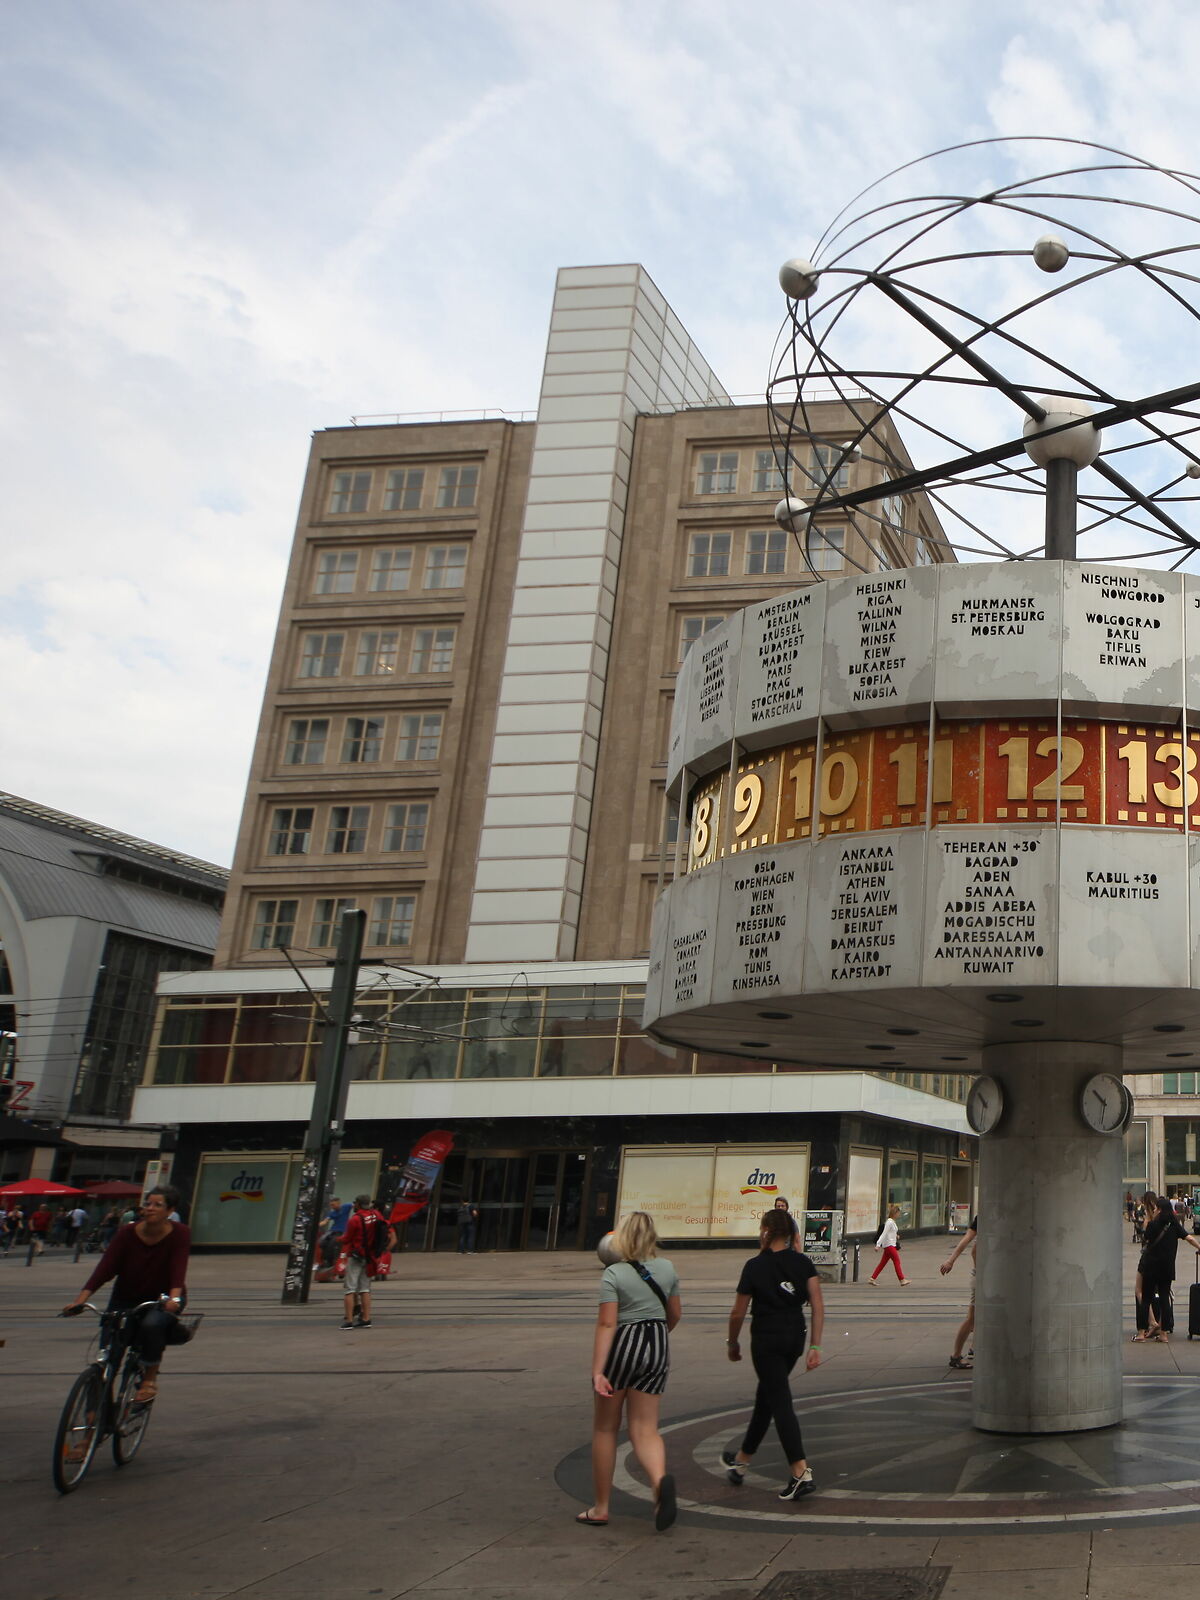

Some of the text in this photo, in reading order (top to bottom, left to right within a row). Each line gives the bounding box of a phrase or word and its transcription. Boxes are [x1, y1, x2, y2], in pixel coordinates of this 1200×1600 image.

[856, 579, 906, 596] HELSINKI
[1082, 574, 1139, 588] NISCHNIJ
[867, 594, 892, 607] RIGA
[1102, 588, 1164, 604] NOWGOROD
[758, 595, 810, 620] AMSTERDAM
[962, 598, 1036, 610] MURMANSK
[767, 611, 799, 629] BERLIN
[858, 606, 902, 621] TALLINN
[951, 611, 1045, 623] ST. PETERSBURG
[1086, 612, 1160, 628] WOLGOGRAD
[862, 620, 896, 634] WILNA
[971, 625, 1024, 636] MOSKAU
[1107, 628, 1139, 640] BAKU
[759, 634, 804, 656] BUDAPEST
[860, 633, 896, 647] MINSK
[864, 647, 890, 660] KIEW
[1106, 642, 1141, 654] TIFLIS
[706, 655, 724, 673] DUBLIN
[762, 650, 798, 668] MADRID
[849, 658, 906, 675] BUKAREST
[1100, 654, 1146, 668] ERIWAN
[704, 666, 724, 686] LONDON
[767, 664, 792, 680] PARIS
[766, 677, 790, 692] PRAG
[860, 674, 892, 686] SOFIA
[700, 677, 724, 700] LISSABON
[853, 686, 898, 702] NIKOSIA
[700, 691, 724, 712] MADEIRA
[752, 686, 804, 710] STOCKHOLM
[702, 704, 720, 722] BISSAU
[752, 700, 802, 722] WARSCHAU
[889, 739, 953, 806] 11
[998, 736, 1085, 801] 12
[1118, 740, 1198, 808] 13
[790, 751, 859, 820] 10
[734, 774, 762, 837] 9
[692, 797, 712, 857] 8
[842, 846, 894, 862] ANKARA
[944, 842, 1006, 853] TEHERAN
[754, 861, 776, 874] OSLO
[840, 860, 894, 876] ISTANBUL
[965, 856, 1018, 868] BAGDAD
[734, 872, 794, 892] KOPENHAGEN
[847, 876, 886, 890] ATHEN
[973, 872, 1010, 882] ADEN
[1086, 872, 1158, 884] KABUL +30
[752, 889, 774, 902] WIEN
[840, 890, 890, 905] TEL AVIV
[966, 886, 1015, 898] SANAA
[1089, 886, 1159, 900] MAURITIUS
[750, 904, 774, 916] BERN
[831, 904, 898, 920] JERUSALEM
[944, 900, 1036, 912] ADDIS ABEBA
[736, 916, 786, 933] PRESSBURG
[844, 920, 883, 934] BEIRUT
[944, 916, 1035, 928] MOGADISCHU
[674, 930, 706, 950] CASABLANCA
[740, 930, 780, 947] BELGRAD
[831, 934, 895, 950] DAMASKUS
[944, 931, 1034, 943] DARESSALAM
[750, 946, 768, 960] ROM
[844, 950, 880, 964] KAIRO
[934, 946, 1044, 958] ANTANANARIVO
[744, 961, 771, 974] TUNIS
[832, 965, 892, 980] KAPSTADT
[964, 962, 1014, 974] KUWAIT
[732, 974, 780, 991] KINSHASA
[676, 988, 694, 1002] ACCRA
[231, 1170, 264, 1190] dm
[747, 1168, 776, 1186] dm
[685, 1216, 728, 1224] Gesundheit
